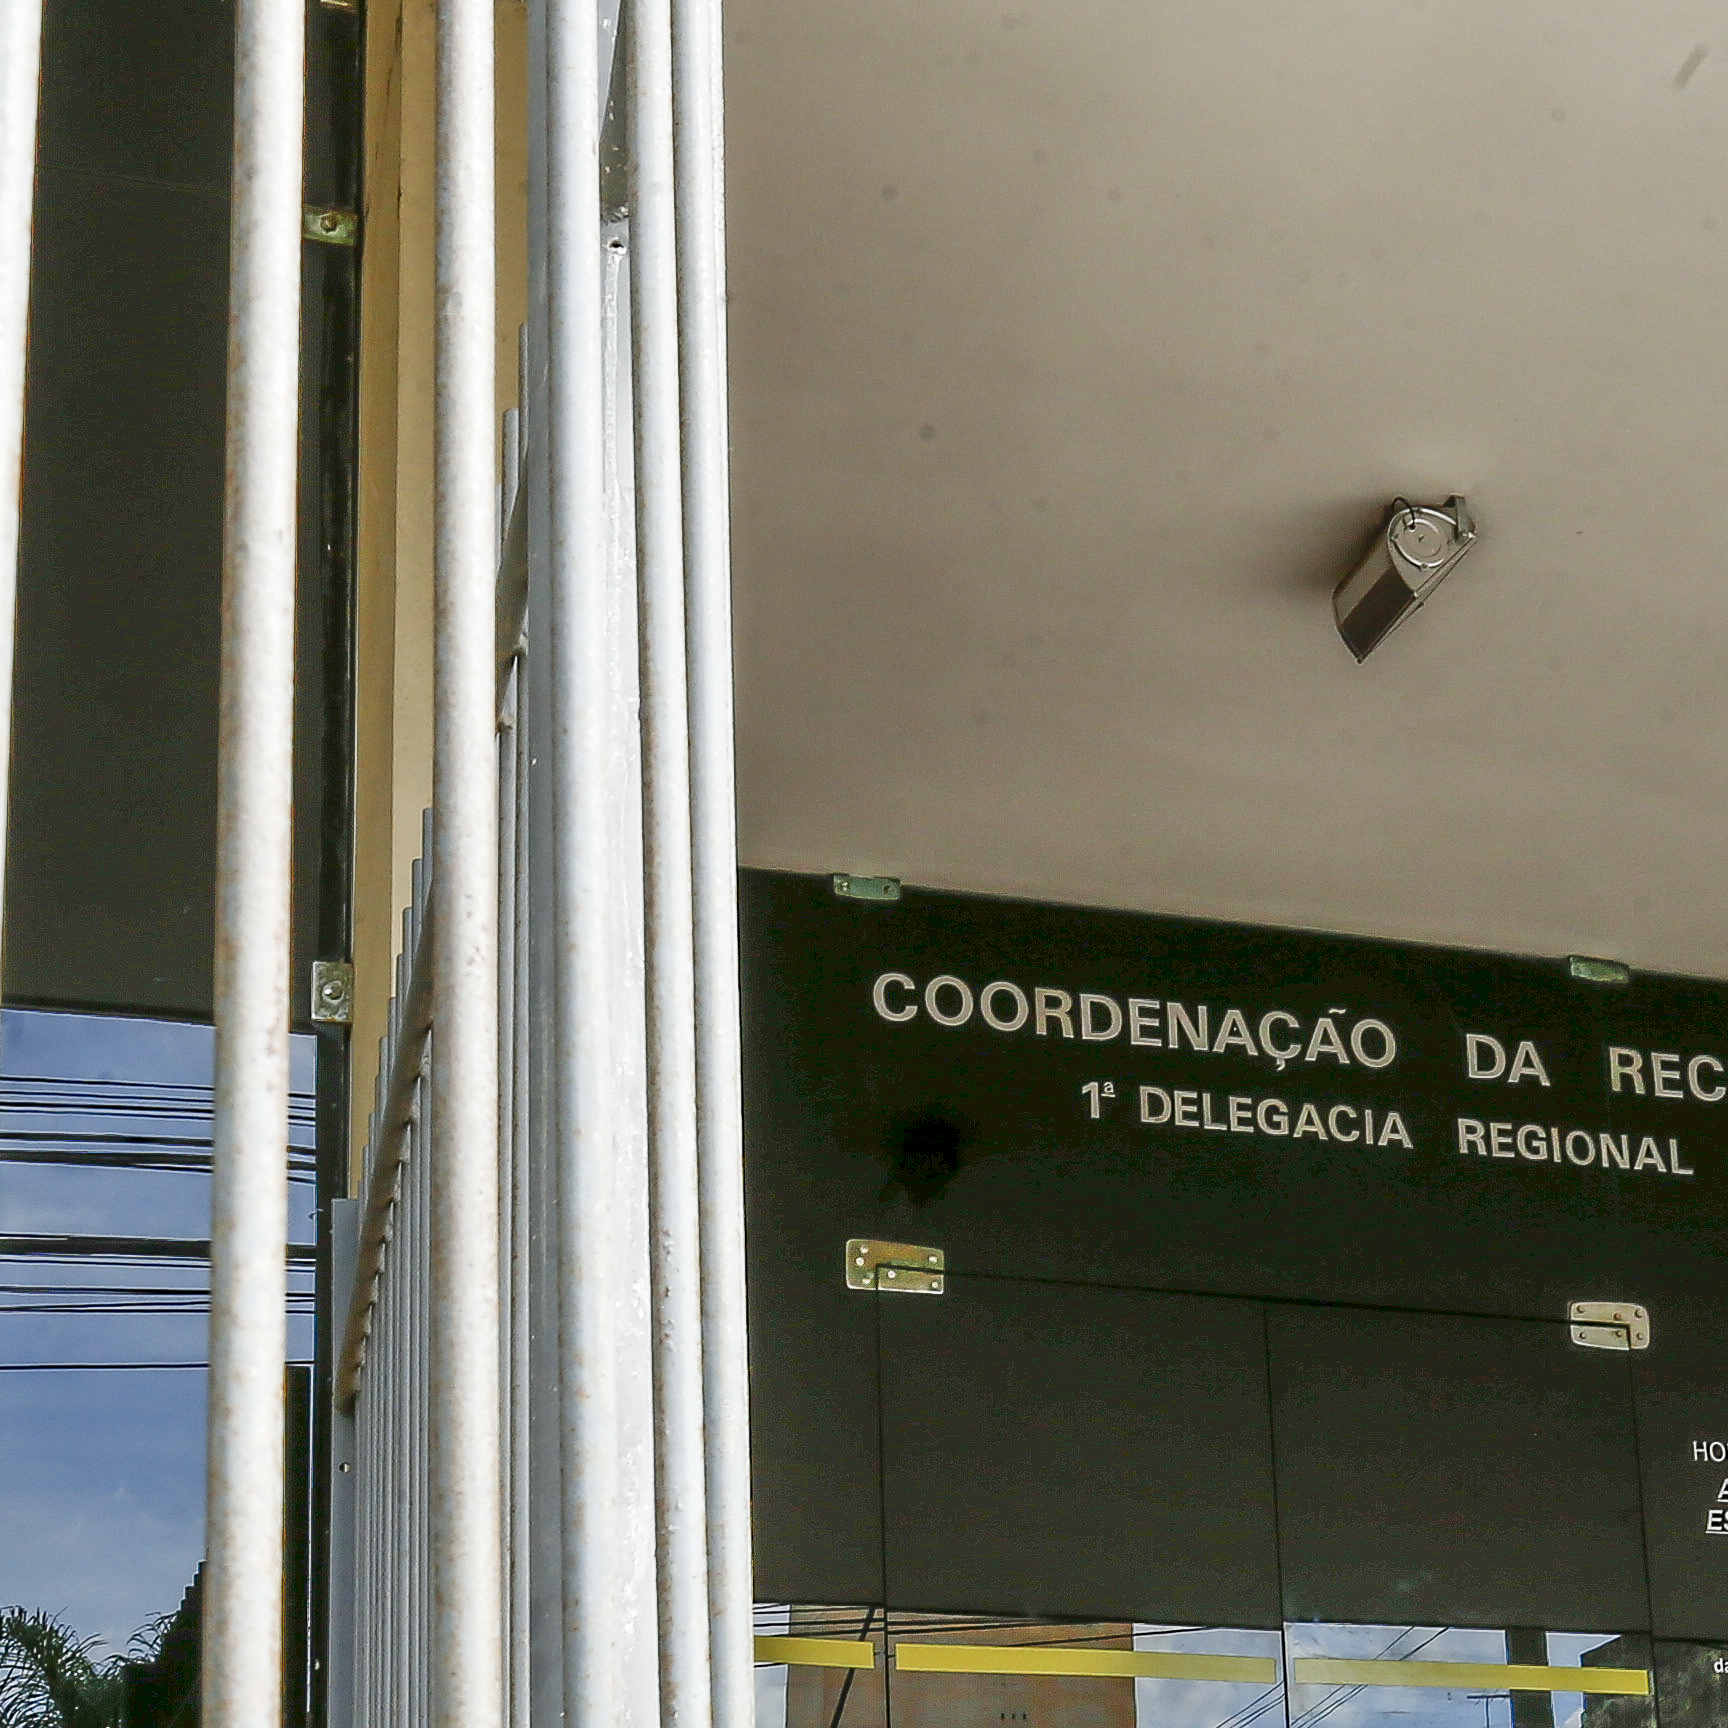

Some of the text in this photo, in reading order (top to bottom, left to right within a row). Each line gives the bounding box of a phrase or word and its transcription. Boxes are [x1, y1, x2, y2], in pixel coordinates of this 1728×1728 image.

[873, 972, 1397, 1069] COORDENAÇÃO
[1467, 1032, 1550, 1086] DA
[1140, 1086, 1413, 1148] DELEGACIA
[1458, 1119, 1693, 1175] REGIONAL
